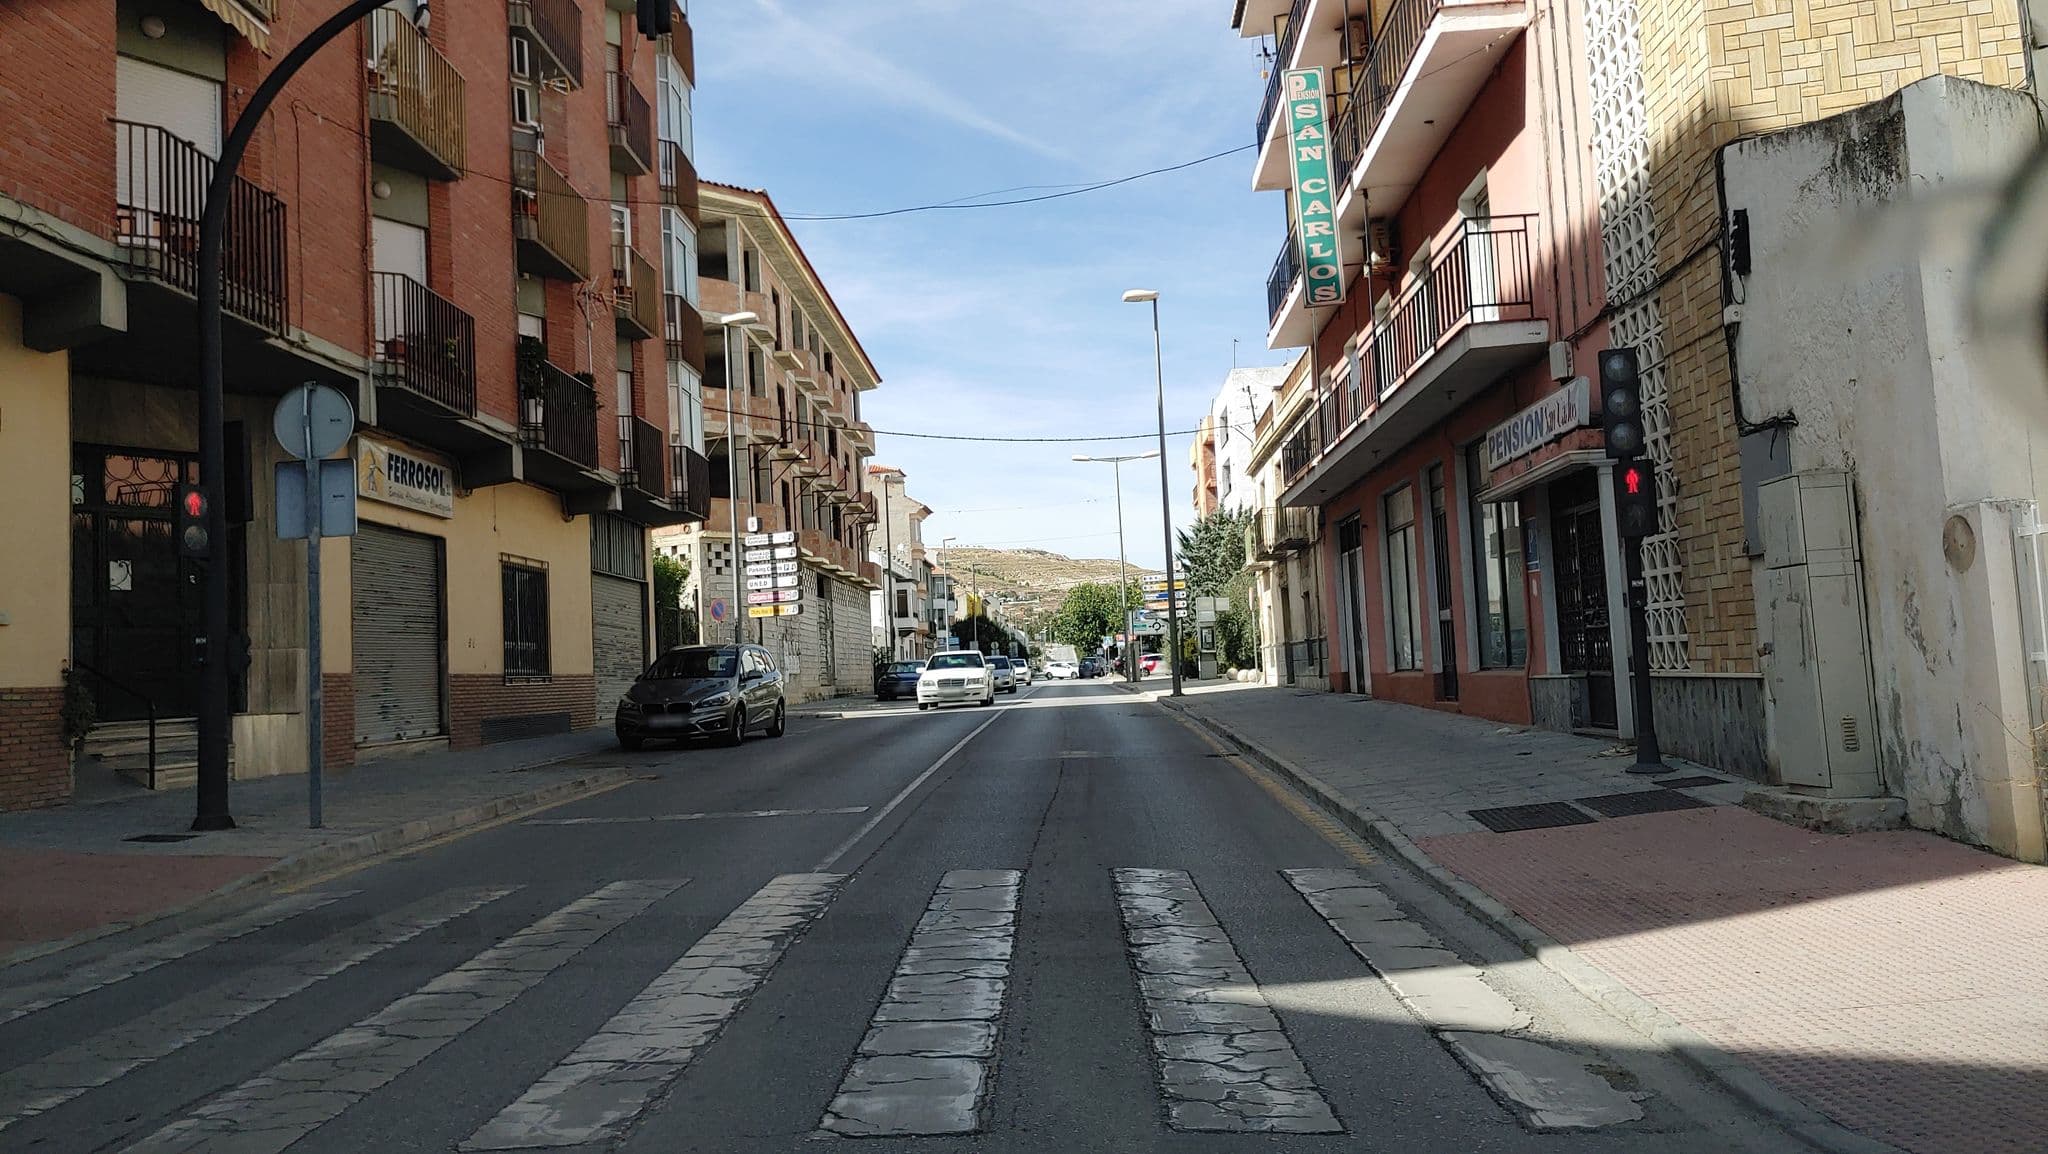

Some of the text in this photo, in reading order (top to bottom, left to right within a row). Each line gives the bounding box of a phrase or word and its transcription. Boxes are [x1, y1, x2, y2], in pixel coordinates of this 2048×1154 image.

[1295, 103, 1337, 302] SAN CARLOS
[1489, 407, 1544, 464] PENSION
[388, 453, 446, 496] FERROSOL
